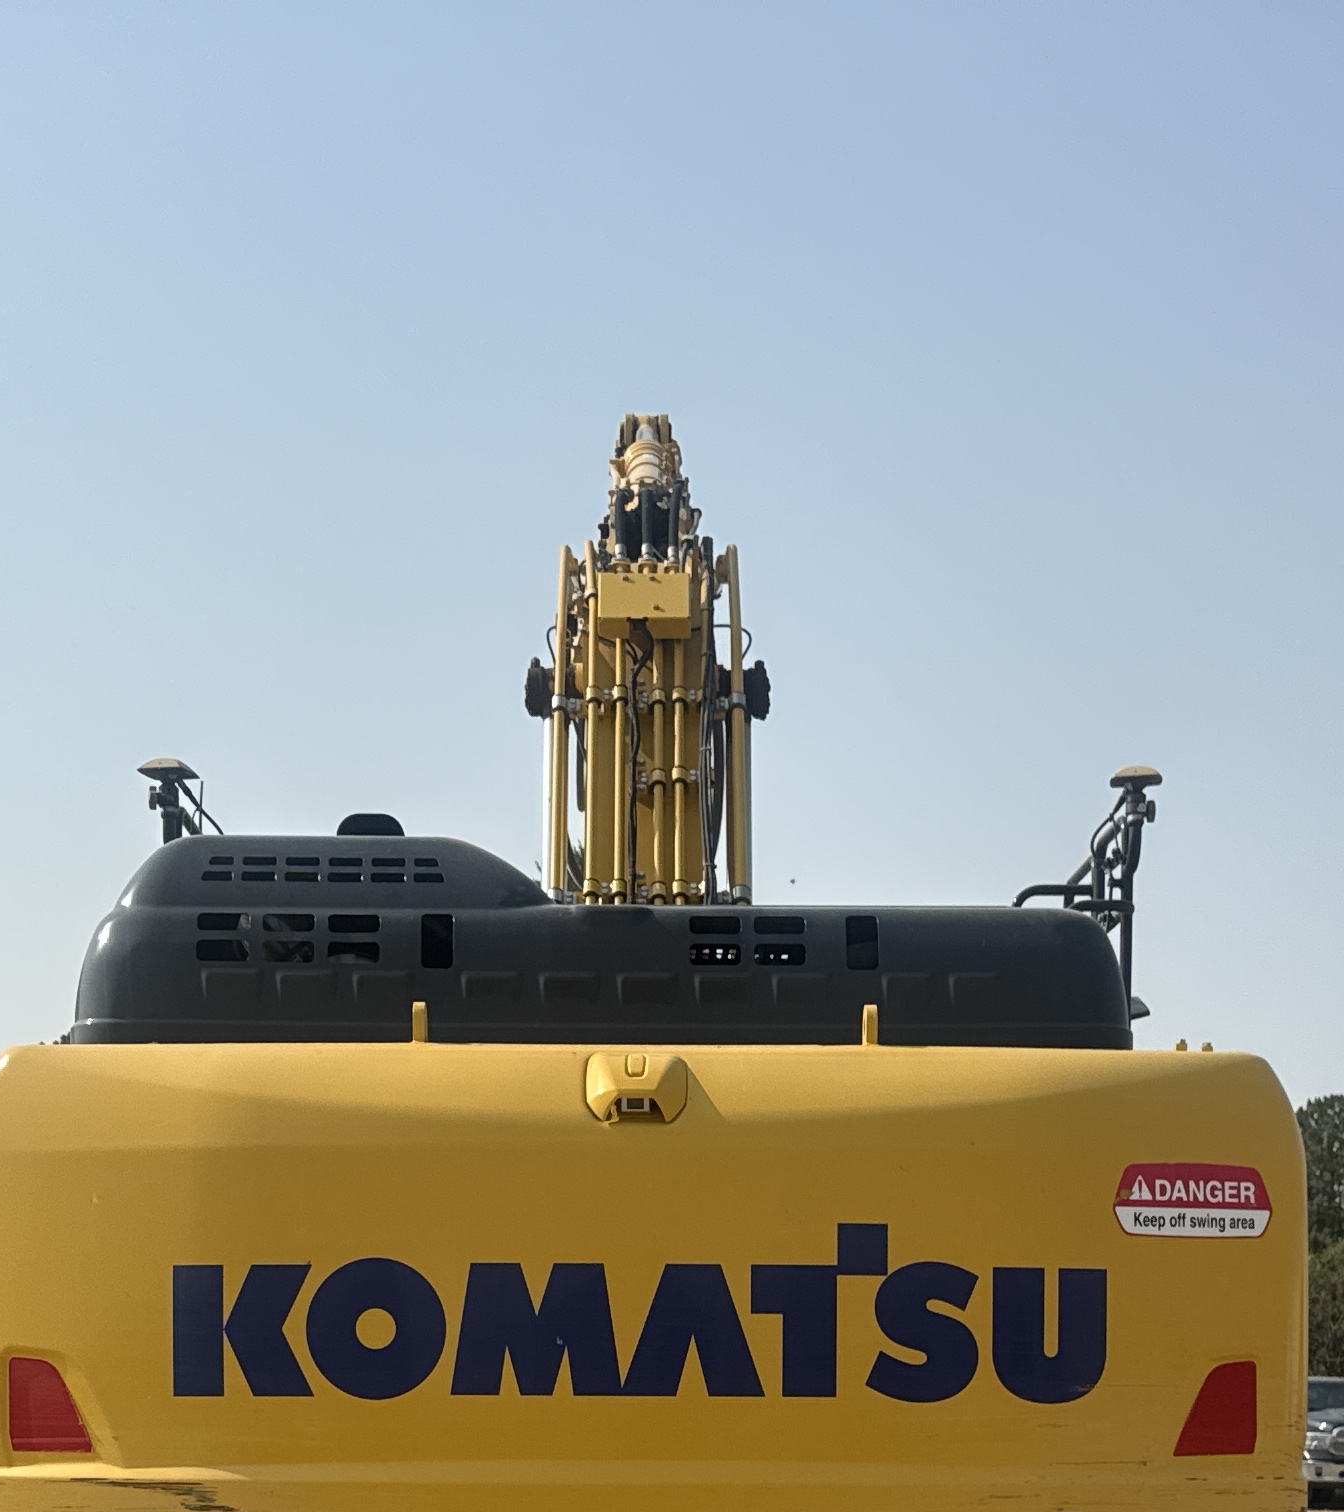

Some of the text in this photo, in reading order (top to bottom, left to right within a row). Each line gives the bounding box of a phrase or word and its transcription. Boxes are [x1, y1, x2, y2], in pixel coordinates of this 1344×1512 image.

[1155, 1179, 1256, 1203] DANGER
[1133, 1212, 1255, 1233] Keep off swing area
[172, 1222, 1108, 1404] KOMATSU
